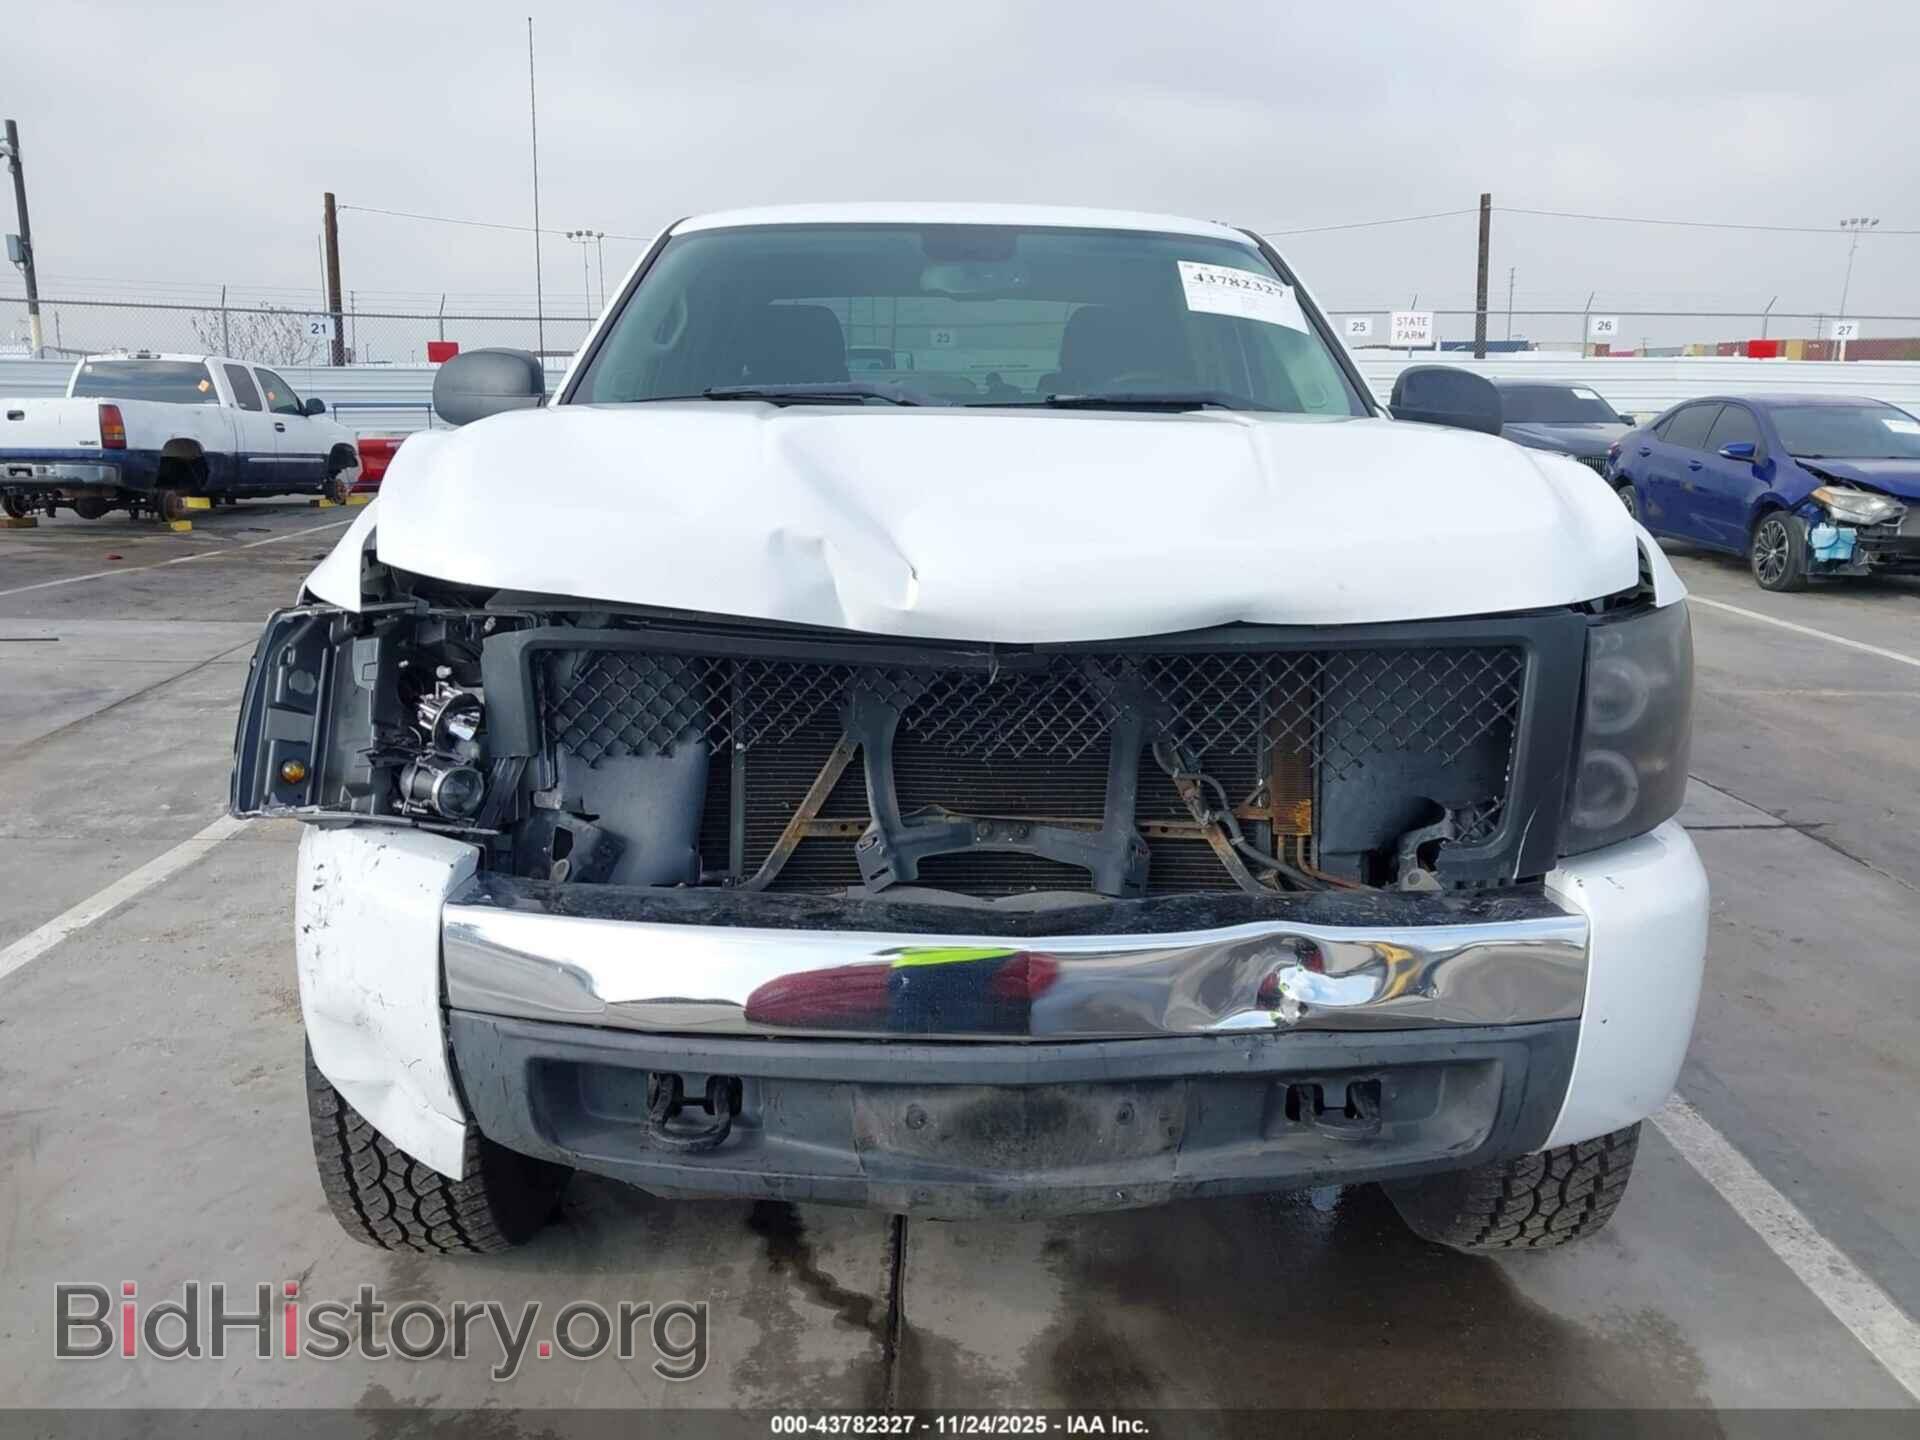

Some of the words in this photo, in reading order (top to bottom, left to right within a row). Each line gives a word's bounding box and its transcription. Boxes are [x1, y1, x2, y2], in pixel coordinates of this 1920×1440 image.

[1193, 272, 1284, 298] 43782327
[1352, 321, 1366, 332] 25
[1397, 317, 1428, 327] STATE
[1598, 320, 1612, 331] 26
[311, 322, 327, 335] 21
[1838, 325, 1852, 336] 27
[1397, 330, 1426, 340] FARM
